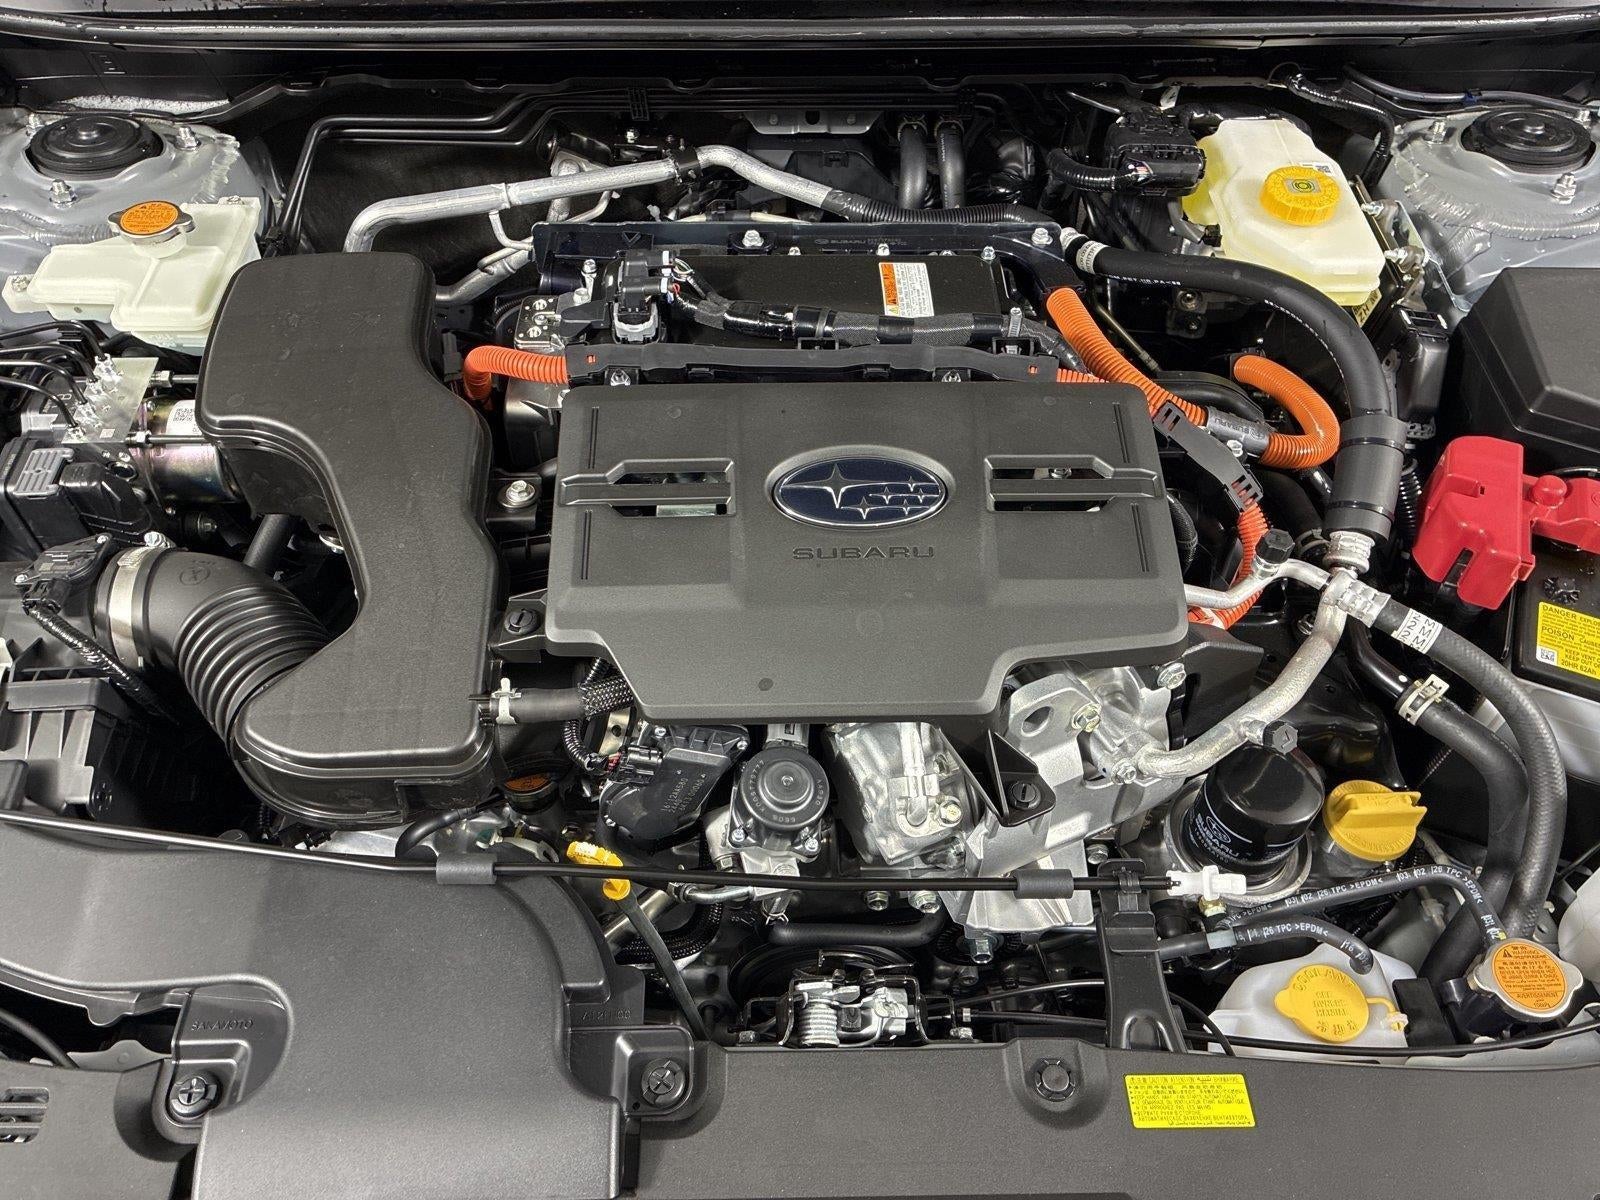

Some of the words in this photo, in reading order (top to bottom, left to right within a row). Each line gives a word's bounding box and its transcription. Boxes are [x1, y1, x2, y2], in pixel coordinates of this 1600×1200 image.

[792, 546, 934, 560] SUBARU
[1542, 604, 1577, 619] DANGER
[1541, 626, 1575, 641] POISON
[1196, 812, 1240, 857] SUBARU
[1446, 866, 1462, 878] TPC
[1331, 884, 1347, 895] TPC
[1276, 922, 1292, 933] TPC
